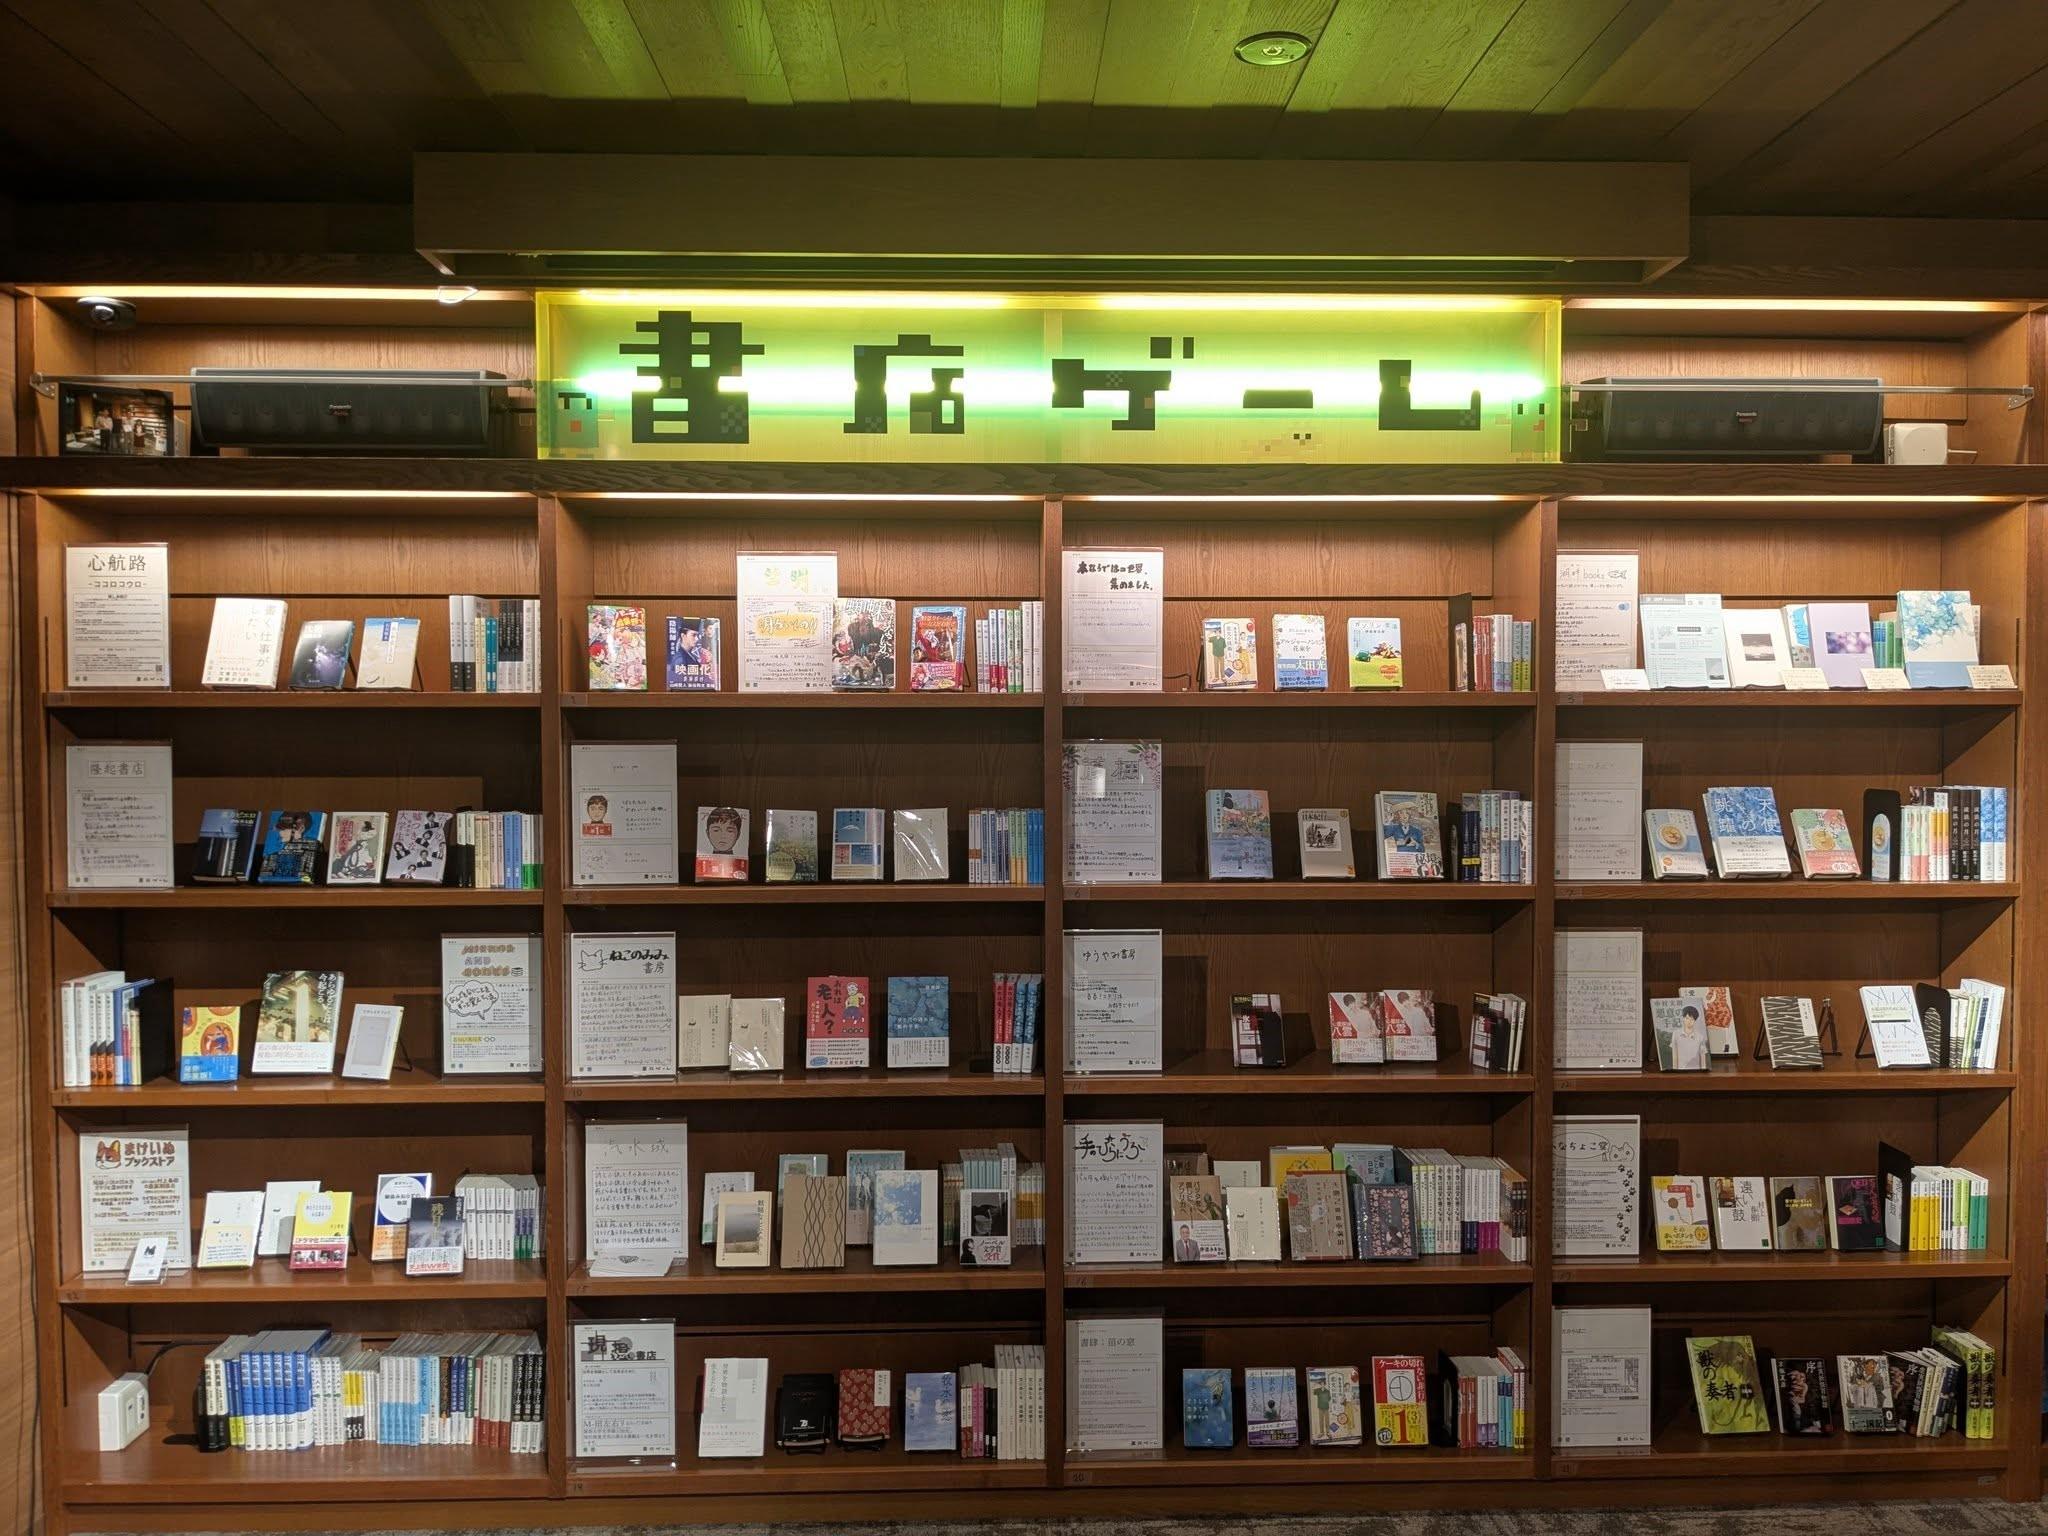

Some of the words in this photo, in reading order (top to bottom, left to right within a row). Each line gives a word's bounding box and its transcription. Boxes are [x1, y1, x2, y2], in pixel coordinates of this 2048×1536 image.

[88, 553, 146, 572] 心航路
[675, 664, 711, 675] 映画化
[1295, 660, 1327, 670] 太田光
[1759, 797, 1781, 833] 天使
[609, 949, 670, 962] ねこのみみ
[1082, 948, 1136, 962] ゆうやみ書房
[643, 961, 665, 975] 書房
[124, 1141, 176, 1156] まけいぬ
[124, 1156, 175, 1168] ブックストア
[1740, 1180, 1754, 1206] 遠い
[1732, 1196, 1747, 1222] 太鼓
